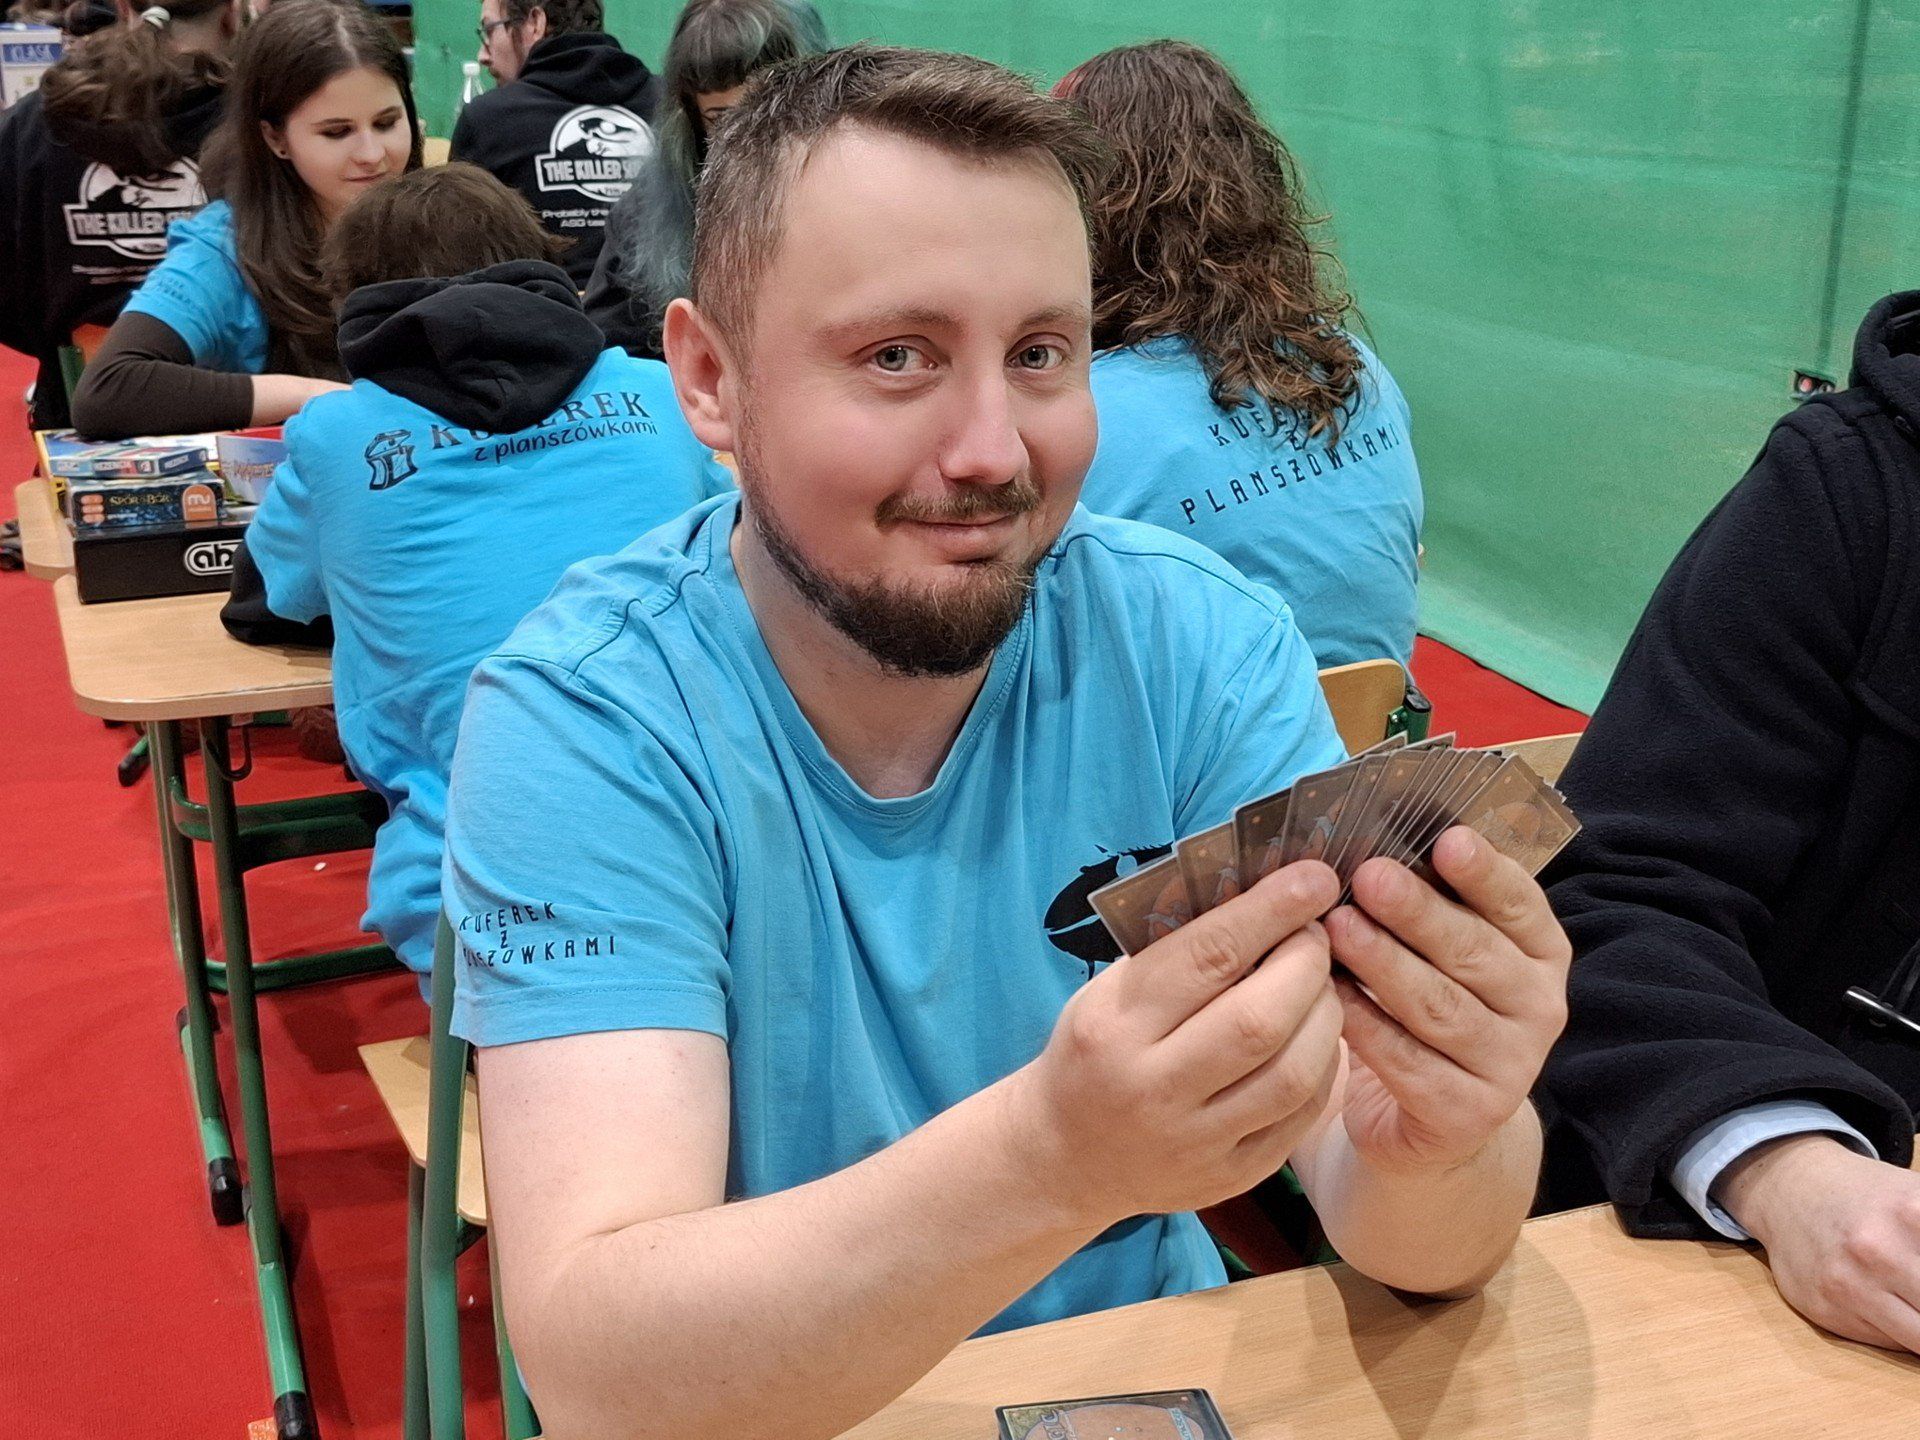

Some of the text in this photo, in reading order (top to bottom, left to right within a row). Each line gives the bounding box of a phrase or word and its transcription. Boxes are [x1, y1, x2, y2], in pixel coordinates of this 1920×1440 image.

[543, 161, 574, 182] THE
[574, 159, 622, 181] KILLER
[72, 212, 107, 236] THE
[107, 211, 165, 234] KILLER
[431, 391, 650, 449] KREK
[474, 419, 658, 464] z planszówkami
[193, 544, 234, 569] ab
[459, 902, 556, 933] KUFEREK
[501, 930, 510, 949] Z
